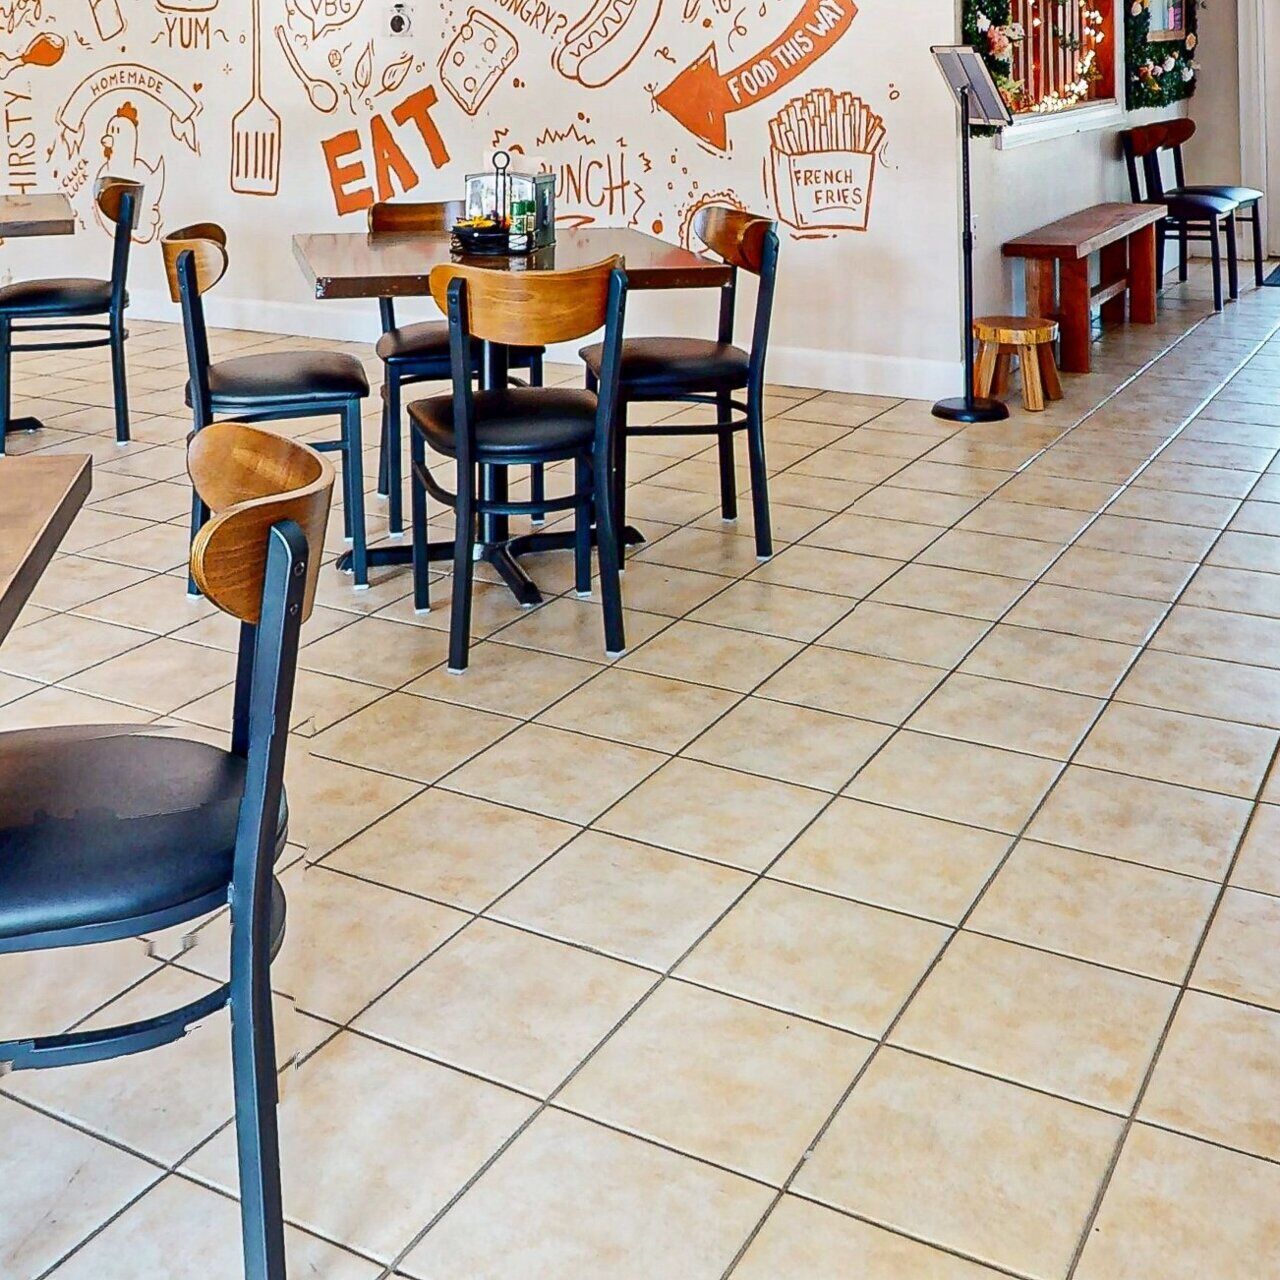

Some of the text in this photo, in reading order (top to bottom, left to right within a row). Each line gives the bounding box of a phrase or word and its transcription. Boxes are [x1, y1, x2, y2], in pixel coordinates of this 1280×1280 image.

[165, 17, 210, 50] YUM
[727, 58, 779, 106] FOOD
[770, 32, 815, 72] THIS
[90, 71, 164, 96] HOMEMADE
[321, 84, 451, 216] EAT
[67, 173, 89, 199] LUCK
[794, 169, 853, 186] FRENCH
[815, 188, 862, 205] FRIES
